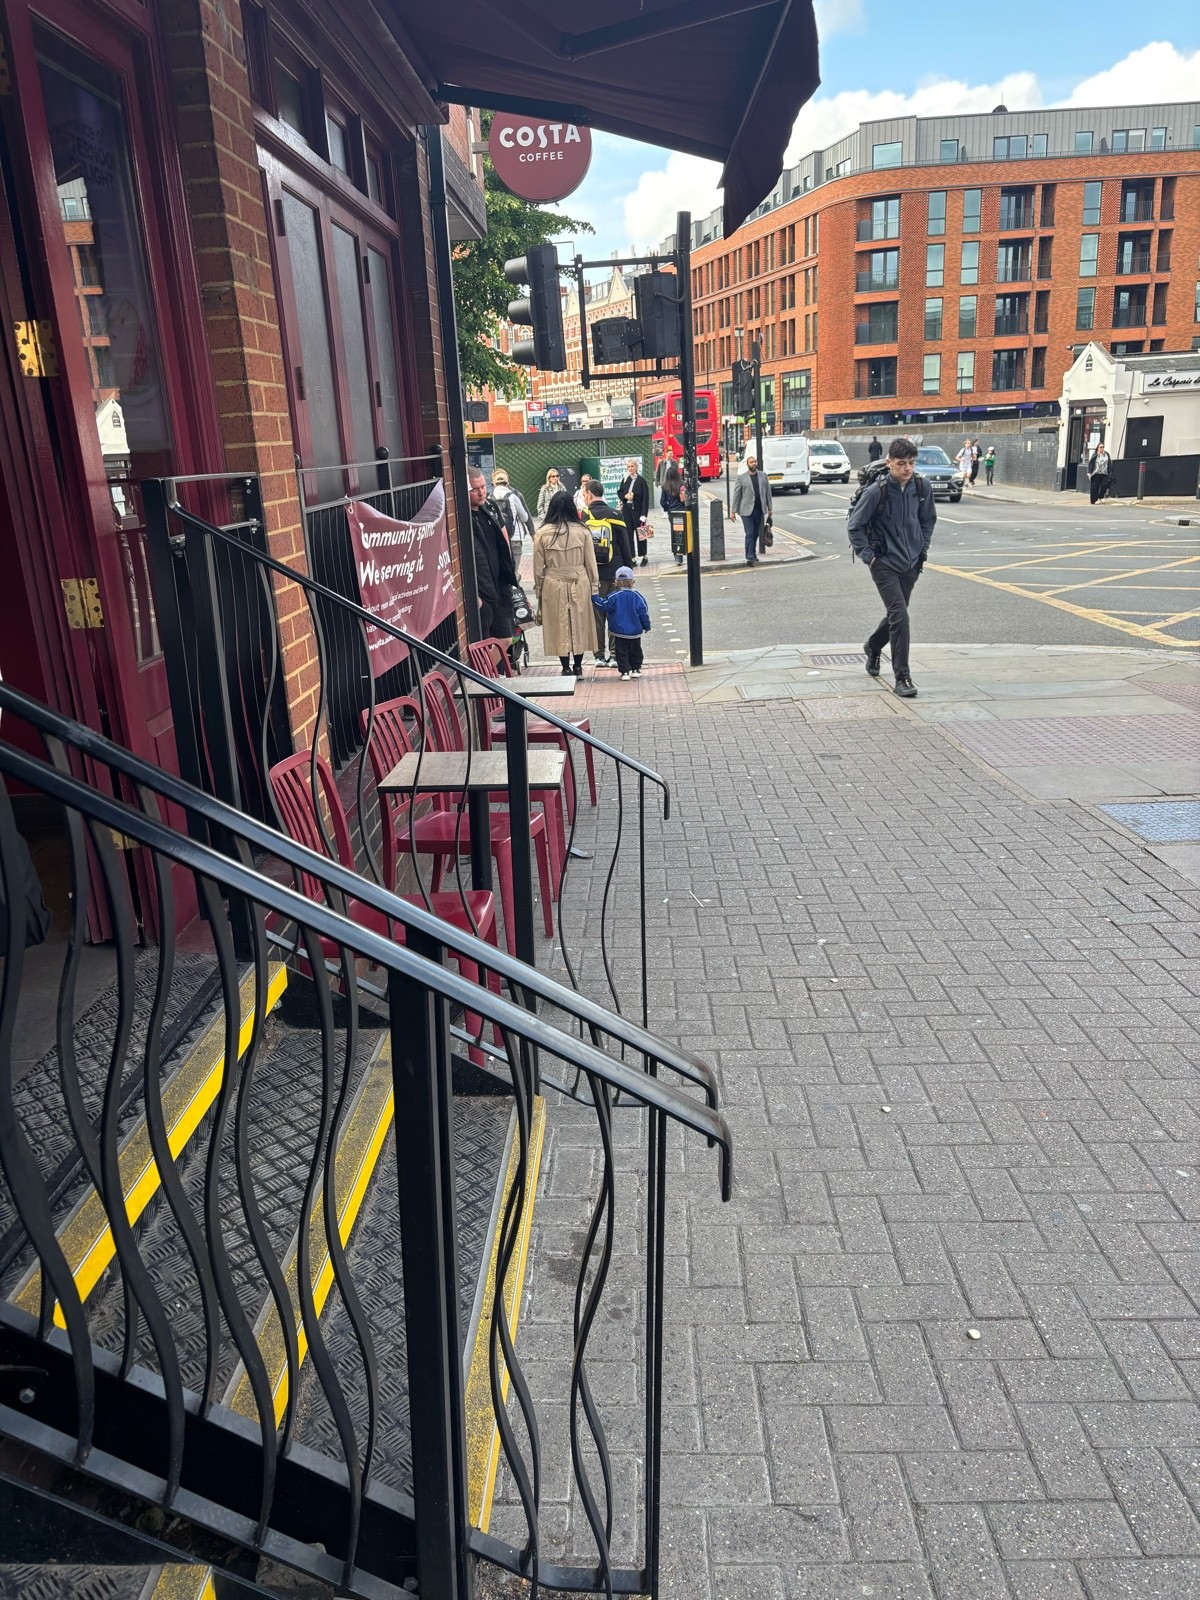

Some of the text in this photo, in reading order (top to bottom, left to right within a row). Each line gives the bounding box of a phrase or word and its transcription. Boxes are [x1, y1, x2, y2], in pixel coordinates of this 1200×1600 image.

[499, 124, 581, 148] COSTA
[519, 151, 564, 162] COFFEE
[381, 554, 416, 584] serving
